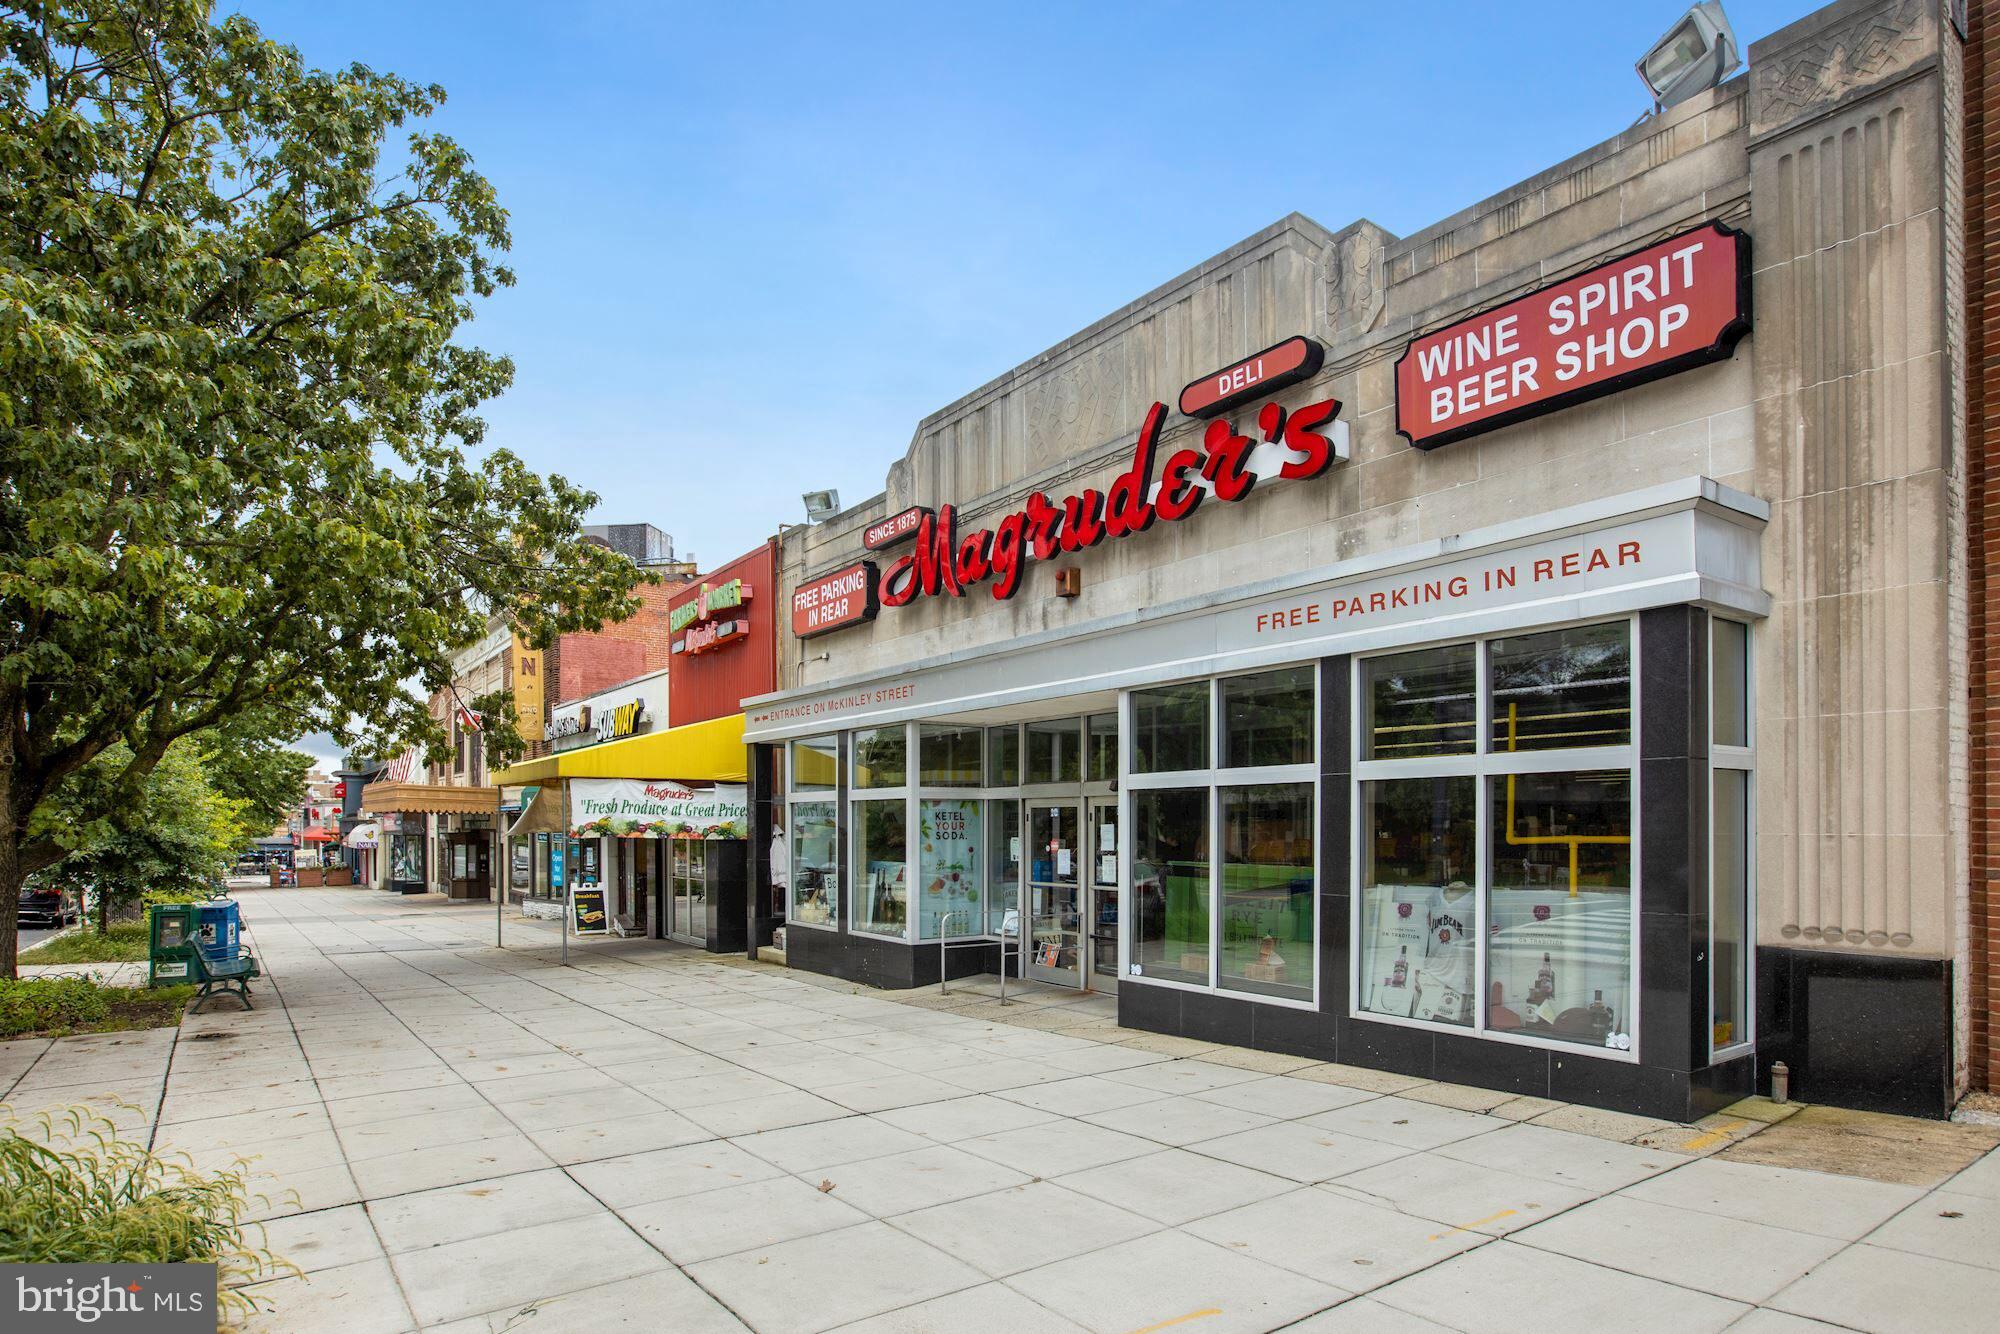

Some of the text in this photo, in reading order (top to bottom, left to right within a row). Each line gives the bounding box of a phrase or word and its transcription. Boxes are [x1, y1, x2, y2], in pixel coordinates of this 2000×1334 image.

[1418, 242, 1704, 383] WINE SPIRIT
[1218, 360, 1263, 397] DELI
[1430, 303, 1690, 424] BEER SHOP
[878, 399, 1343, 607] Magruder's
[869, 512, 917, 544] SINCE 1875
[794, 571, 864, 612] FREE PARKING
[1256, 541, 1642, 633] FREE PARKING IN REAR
[808, 598, 849, 627] IN REAR
[596, 698, 641, 741] SUBWAY
[770, 684, 917, 722] ENTRANCE ON McKINLEY STREET
[620, 799, 668, 816] Produce
[671, 801, 683, 816] at
[685, 802, 715, 817] Great
[644, 784, 694, 801] Magruder's
[935, 811, 965, 821] KETEL
[935, 821, 965, 831] YOUR
[935, 831, 968, 840] SODA.
[1431, 914, 1464, 937] JIM BEAM
